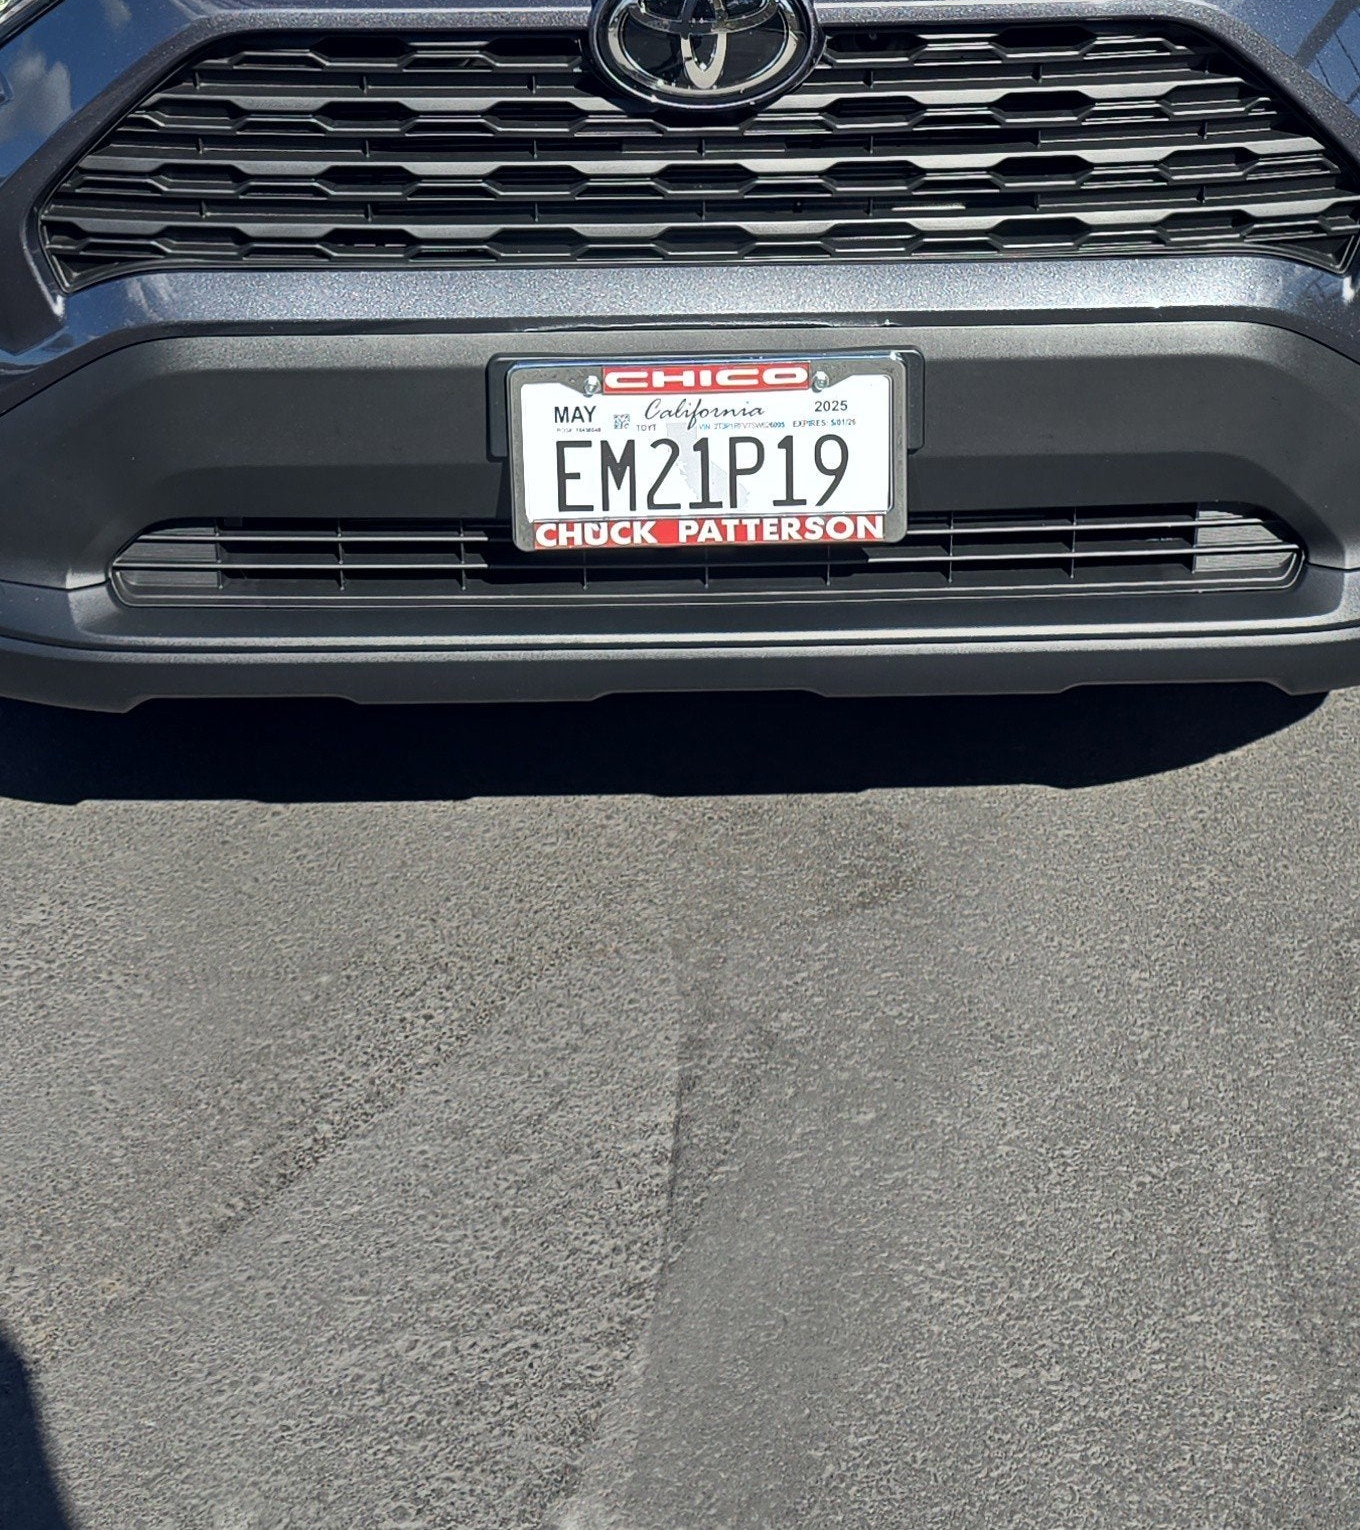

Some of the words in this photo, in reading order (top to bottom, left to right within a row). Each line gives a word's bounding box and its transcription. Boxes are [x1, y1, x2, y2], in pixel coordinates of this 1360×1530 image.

[604, 367, 808, 389] CHICO
[554, 405, 597, 424] MAY
[644, 397, 765, 431] California
[814, 399, 848, 413] 2025
[556, 434, 850, 513] EM21P19
[535, 521, 658, 548] CHUCK
[678, 513, 884, 545] PATTERSON
